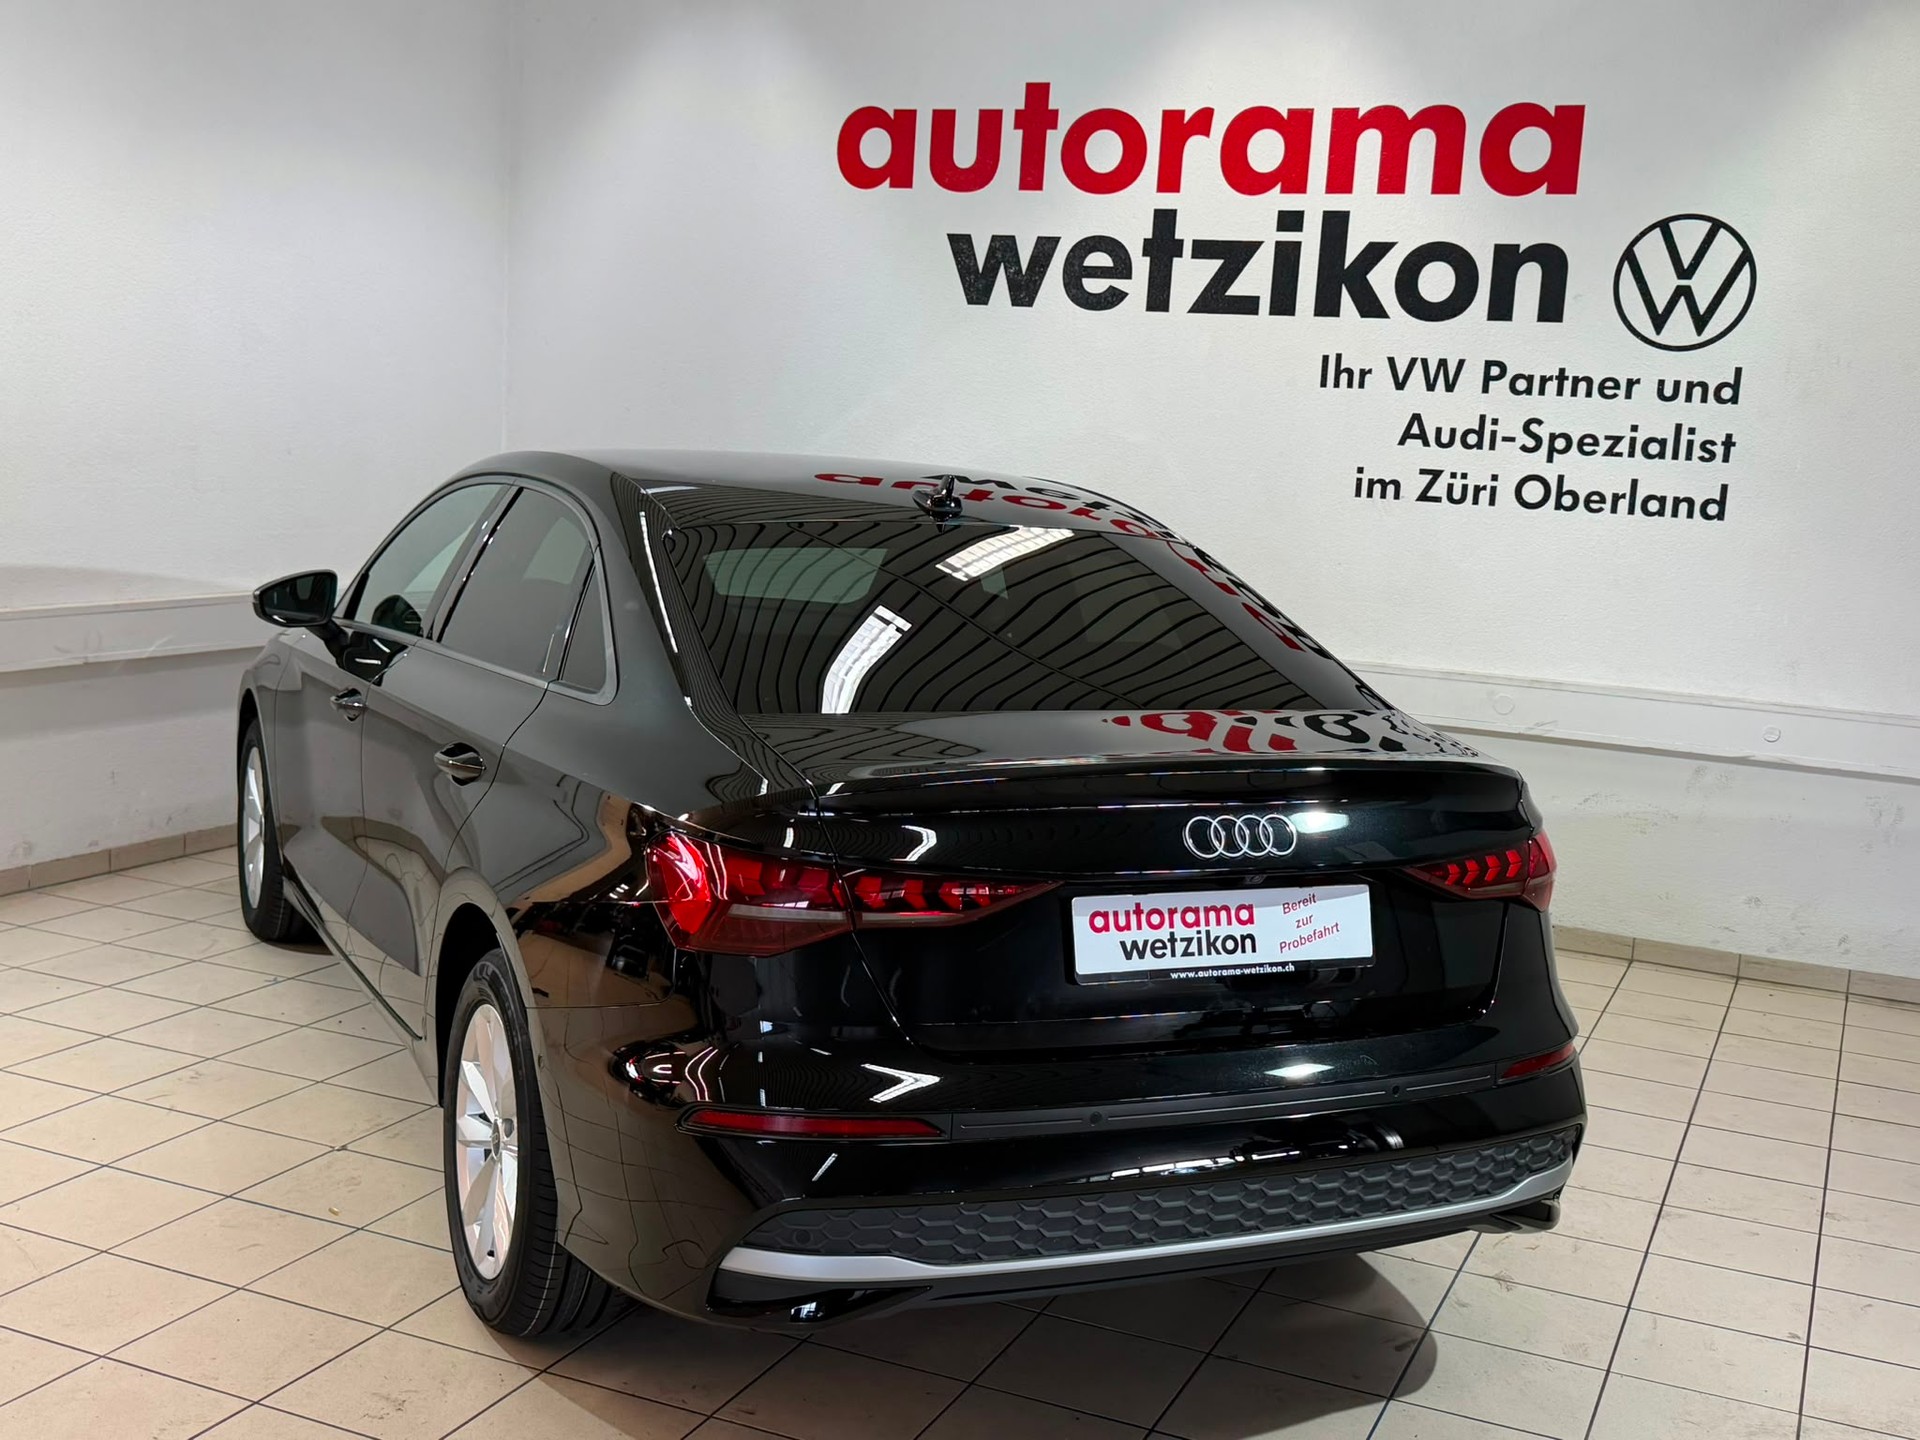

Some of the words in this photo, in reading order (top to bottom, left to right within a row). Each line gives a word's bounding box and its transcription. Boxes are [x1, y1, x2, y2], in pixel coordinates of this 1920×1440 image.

[837, 82, 1586, 197] autorama
[946, 208, 1569, 324] wetzikon
[1319, 353, 1373, 390] Ihr
[1386, 356, 1466, 393] VW
[1481, 359, 1641, 401] Partner
[1656, 366, 1743, 405] und
[1397, 412, 1737, 465] Audi-Spezialist
[1354, 466, 1401, 501] im
[1415, 468, 1499, 508] Züri
[1514, 474, 1729, 522] Oberland
[1088, 902, 1256, 935] autorama
[1281, 892, 1317, 915] Bereit
[1279, 922, 1340, 954] Probefahrt
[1295, 914, 1314, 929] zur
[1119, 929, 1257, 961] wetzikon
[1170, 962, 1295, 979] www.autorama-wetzikon.ch
